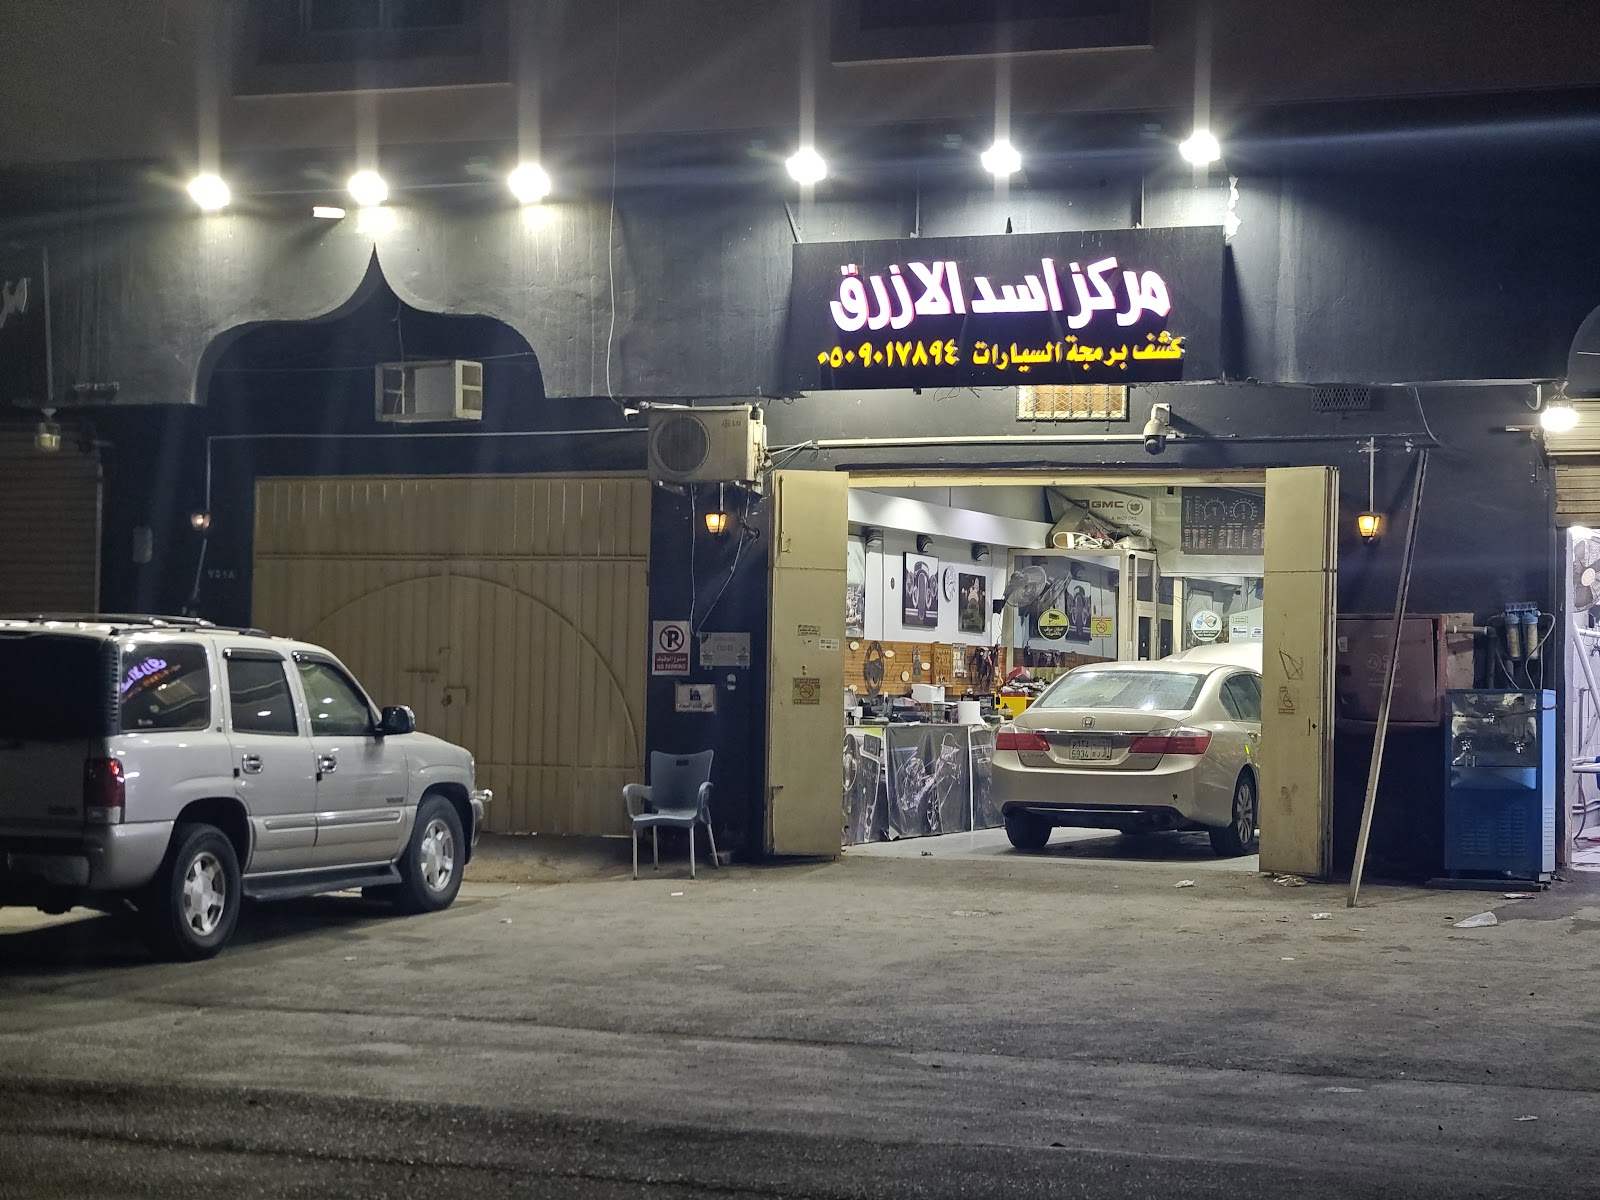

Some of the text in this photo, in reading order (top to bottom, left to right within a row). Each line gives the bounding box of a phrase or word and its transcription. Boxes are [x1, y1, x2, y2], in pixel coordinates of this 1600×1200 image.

[830, 256, 1171, 332] مركز اسد الازرق
[817, 330, 1187, 373] كشف برمجة السيارات ٠٥٠٩٠١٧٨٩٤
[1091, 500, 1124, 509] GMC
[1071, 749, 1089, 759] 5934
